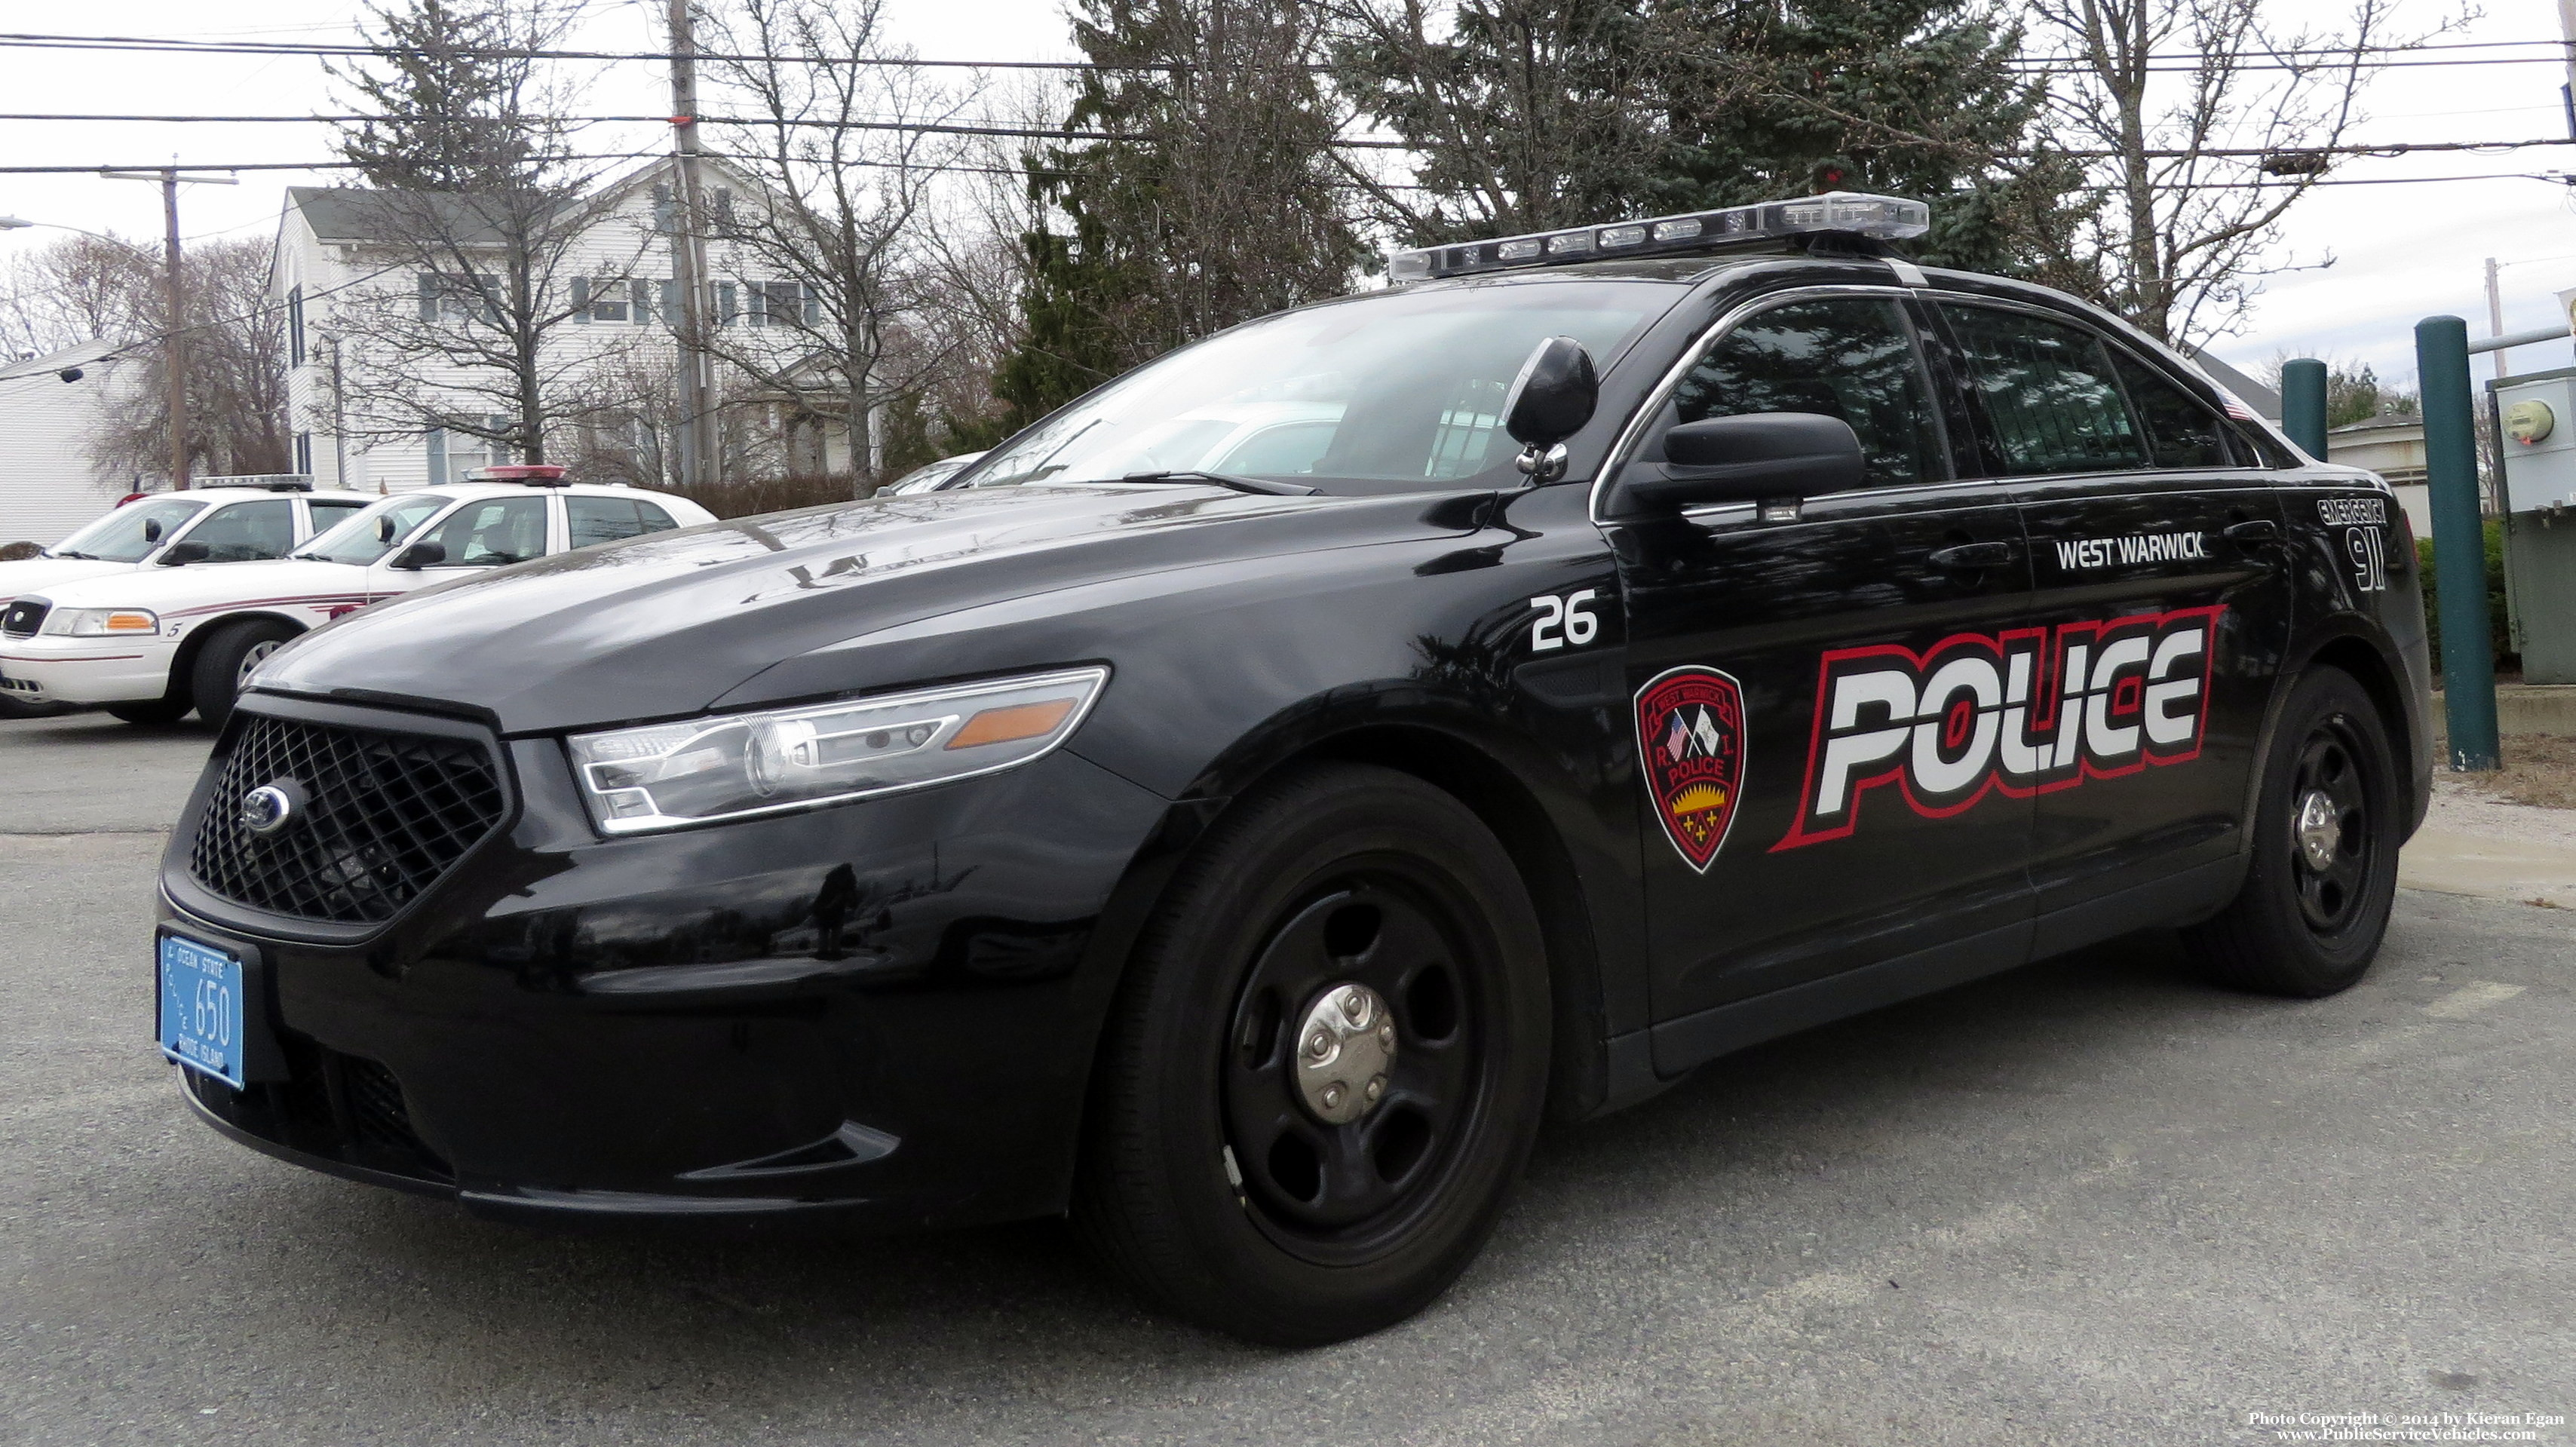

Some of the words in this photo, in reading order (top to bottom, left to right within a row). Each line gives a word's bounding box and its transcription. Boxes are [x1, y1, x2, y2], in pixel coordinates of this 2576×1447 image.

[2317, 498, 2387, 526] EMERGENCY
[2056, 538, 2114, 570] WEST
[2118, 531, 2205, 566] WARWICK
[2346, 526, 2385, 591] 911
[167, 621, 183, 638] 5
[1530, 588, 1598, 651] 26
[1814, 627, 2203, 817] POLICE
[1668, 756, 1725, 786] POLICE
[202, 956, 224, 979] STATE
[196, 978, 229, 1047] 650
